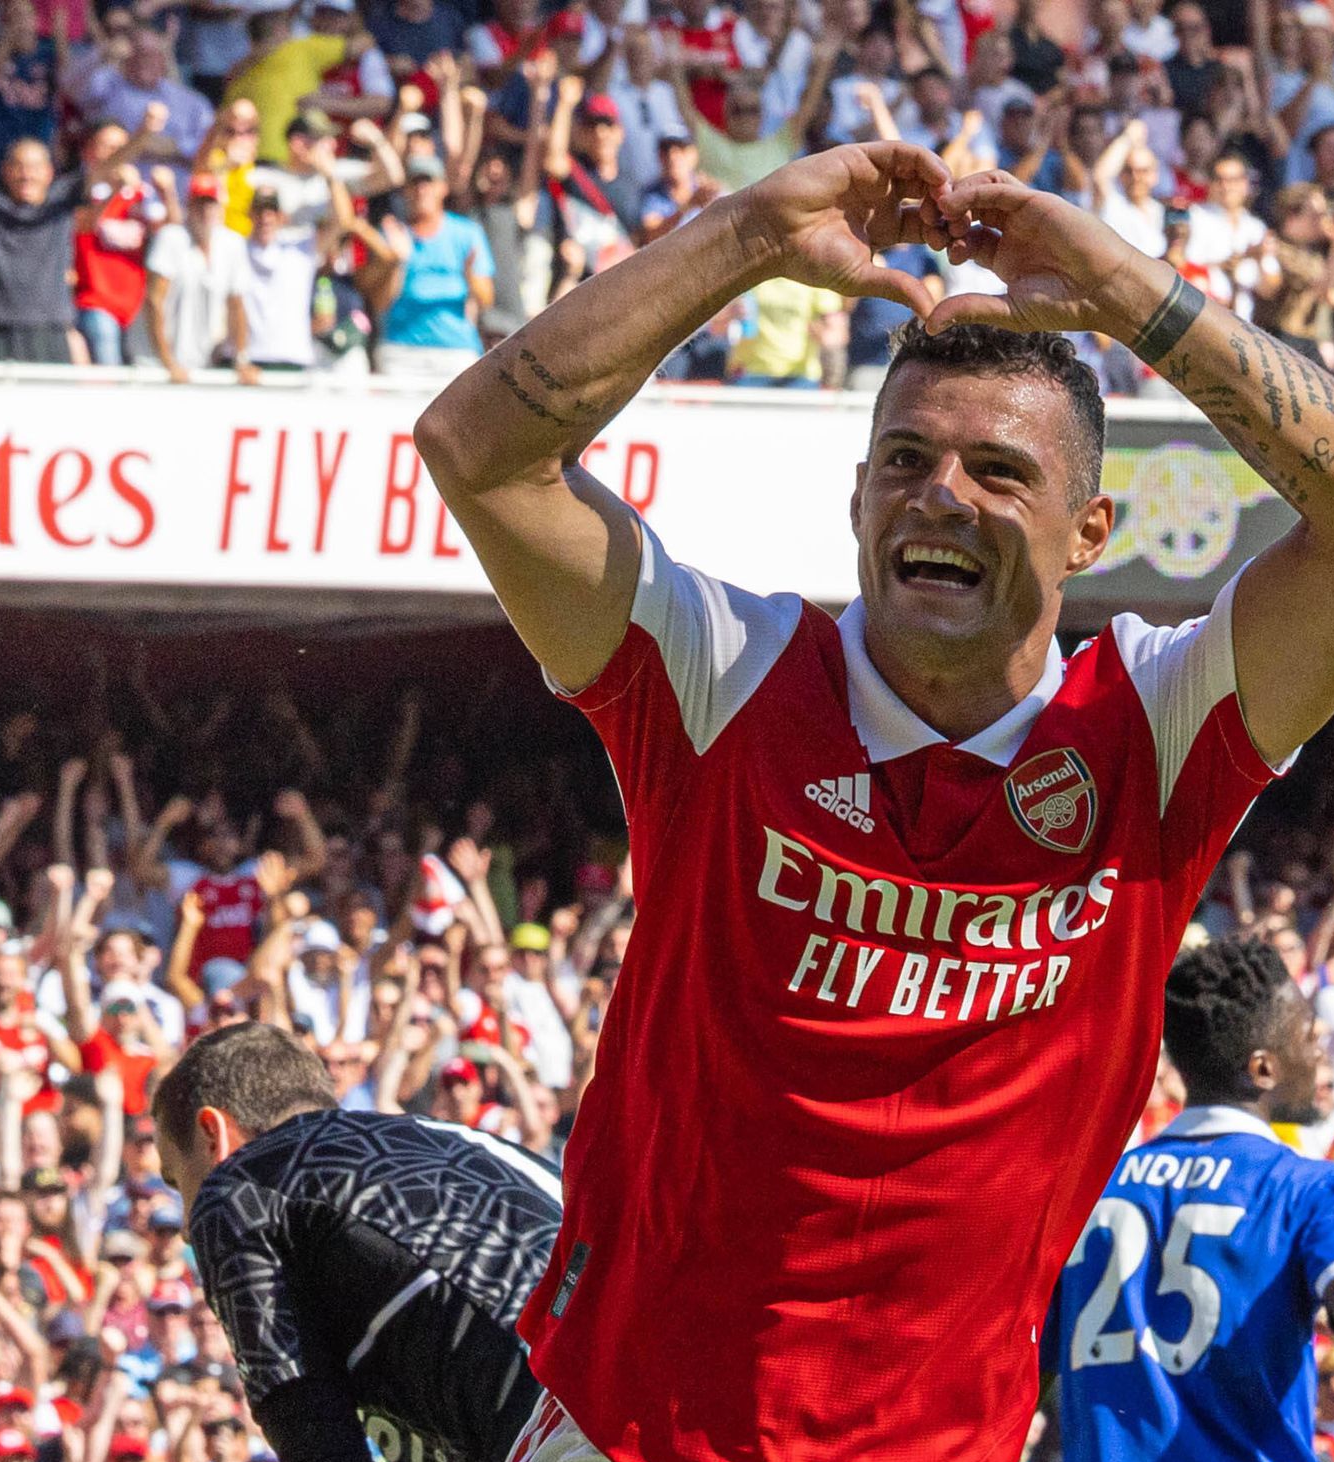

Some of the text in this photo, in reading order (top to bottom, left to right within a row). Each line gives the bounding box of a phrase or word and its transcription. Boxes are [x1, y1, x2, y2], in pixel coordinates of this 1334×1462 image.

[217, 428, 348, 554] FLY
[804, 783, 876, 834] adidas
[1017, 761, 1075, 801] Arsenal
[757, 825, 1119, 950] Emirates
[787, 935, 1071, 1022] FLY BETTER
[1117, 1153, 1232, 1191] NDIDI
[1066, 1196, 1246, 1376] 25
